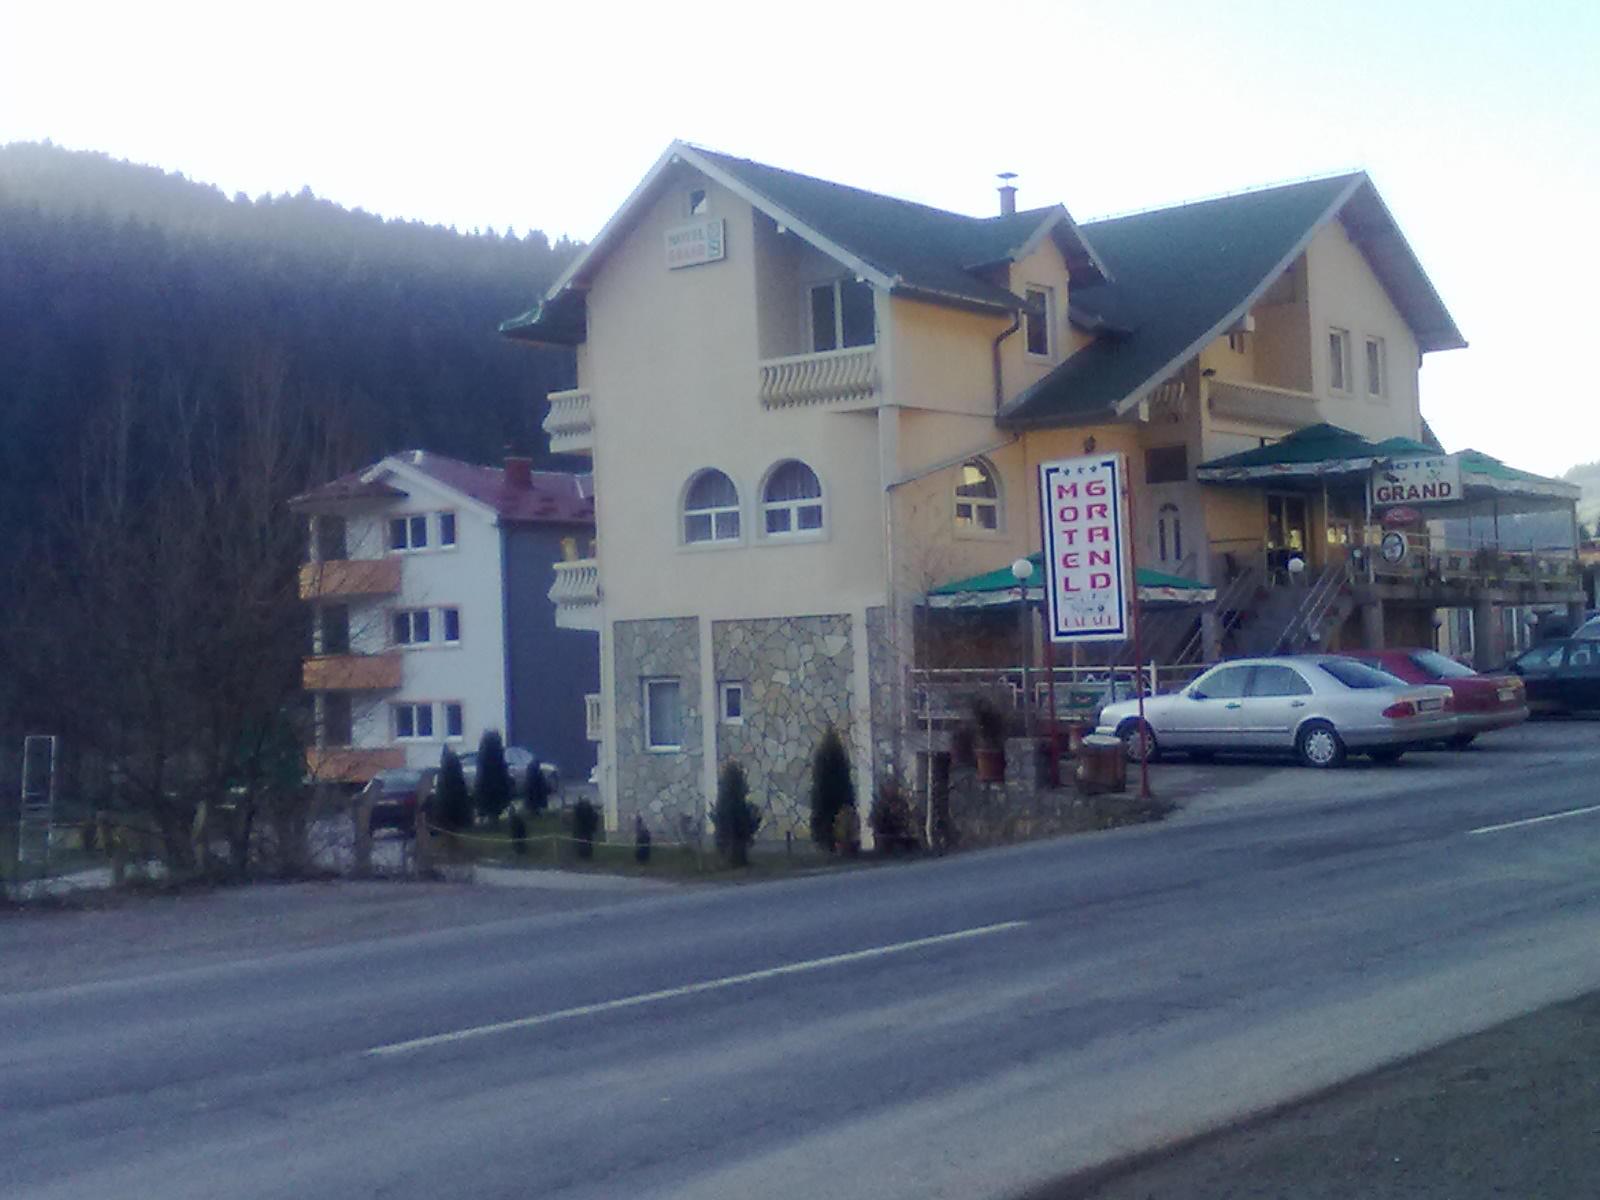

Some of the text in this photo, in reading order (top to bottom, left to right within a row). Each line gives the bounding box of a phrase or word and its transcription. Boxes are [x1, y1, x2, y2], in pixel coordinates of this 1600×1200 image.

[1057, 482, 1081, 592] MOTEL
[1085, 480, 1112, 589] GRAND
[1376, 482, 1452, 501] GRAND
